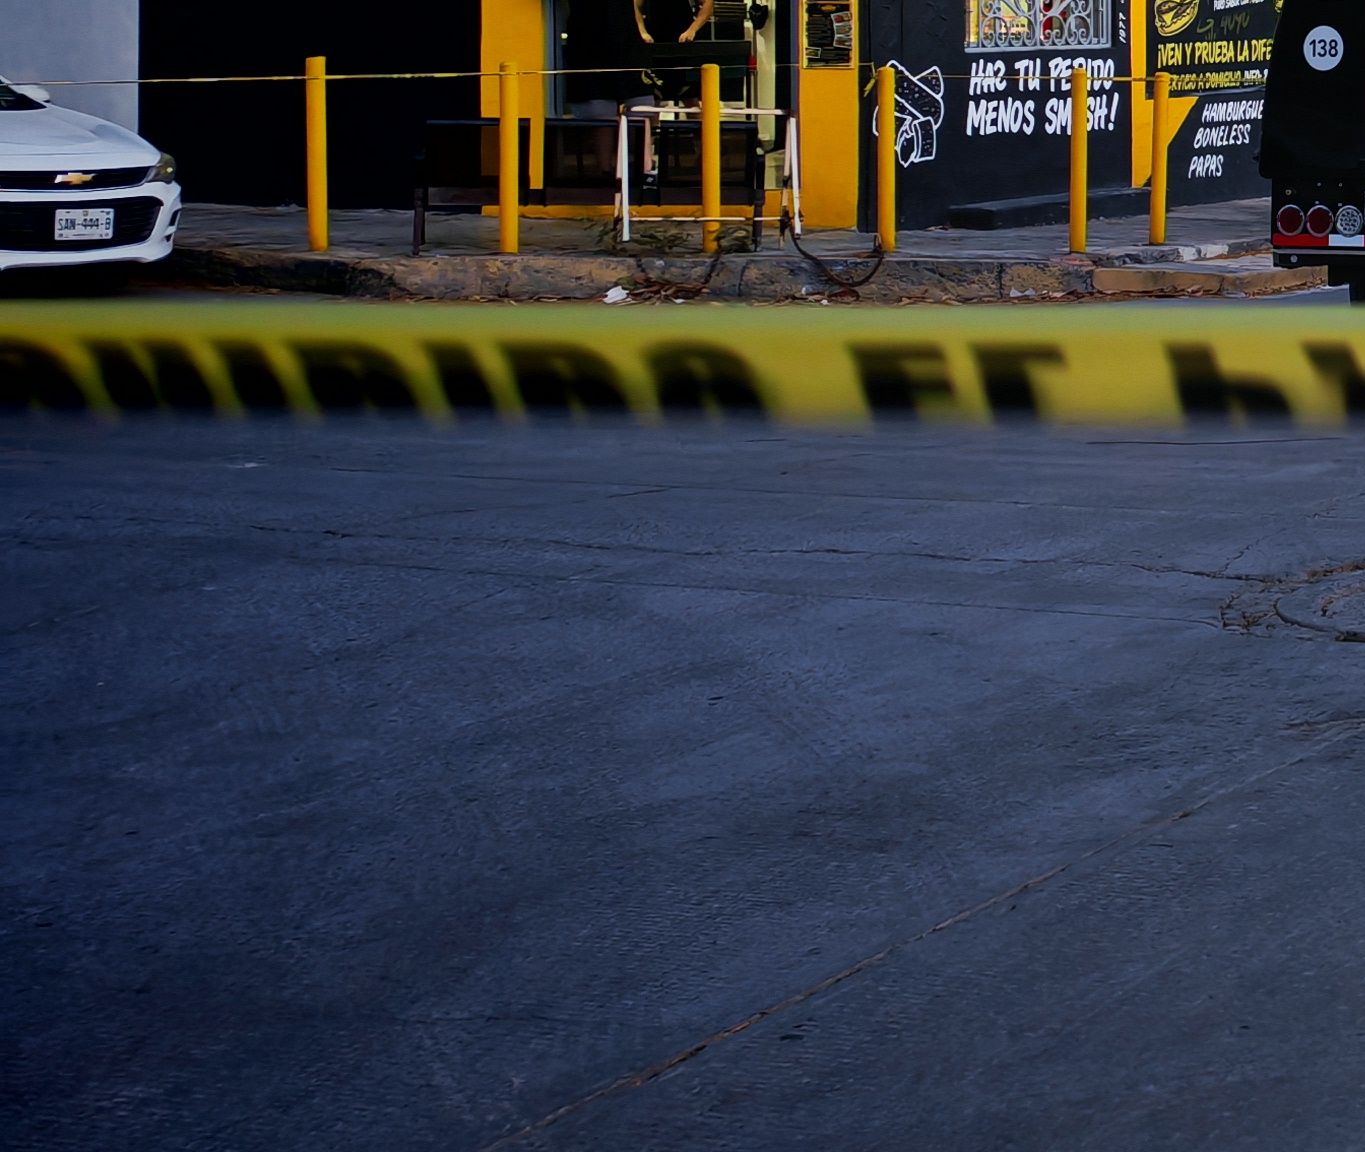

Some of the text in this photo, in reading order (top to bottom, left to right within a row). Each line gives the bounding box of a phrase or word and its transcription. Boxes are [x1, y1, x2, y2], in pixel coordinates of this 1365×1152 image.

[1119, 12, 1127, 44] 1977
[1184, 42, 1193, 65] Y
[1195, 40, 1235, 64] PRUEBA
[1237, 39, 1250, 62] LA
[1308, 38, 1339, 58] 138
[1014, 57, 1041, 92] TU
[966, 92, 1120, 136] MENOS SMSH!
[1193, 123, 1251, 149] BONELESS
[1188, 154, 1224, 179] PAPAS
